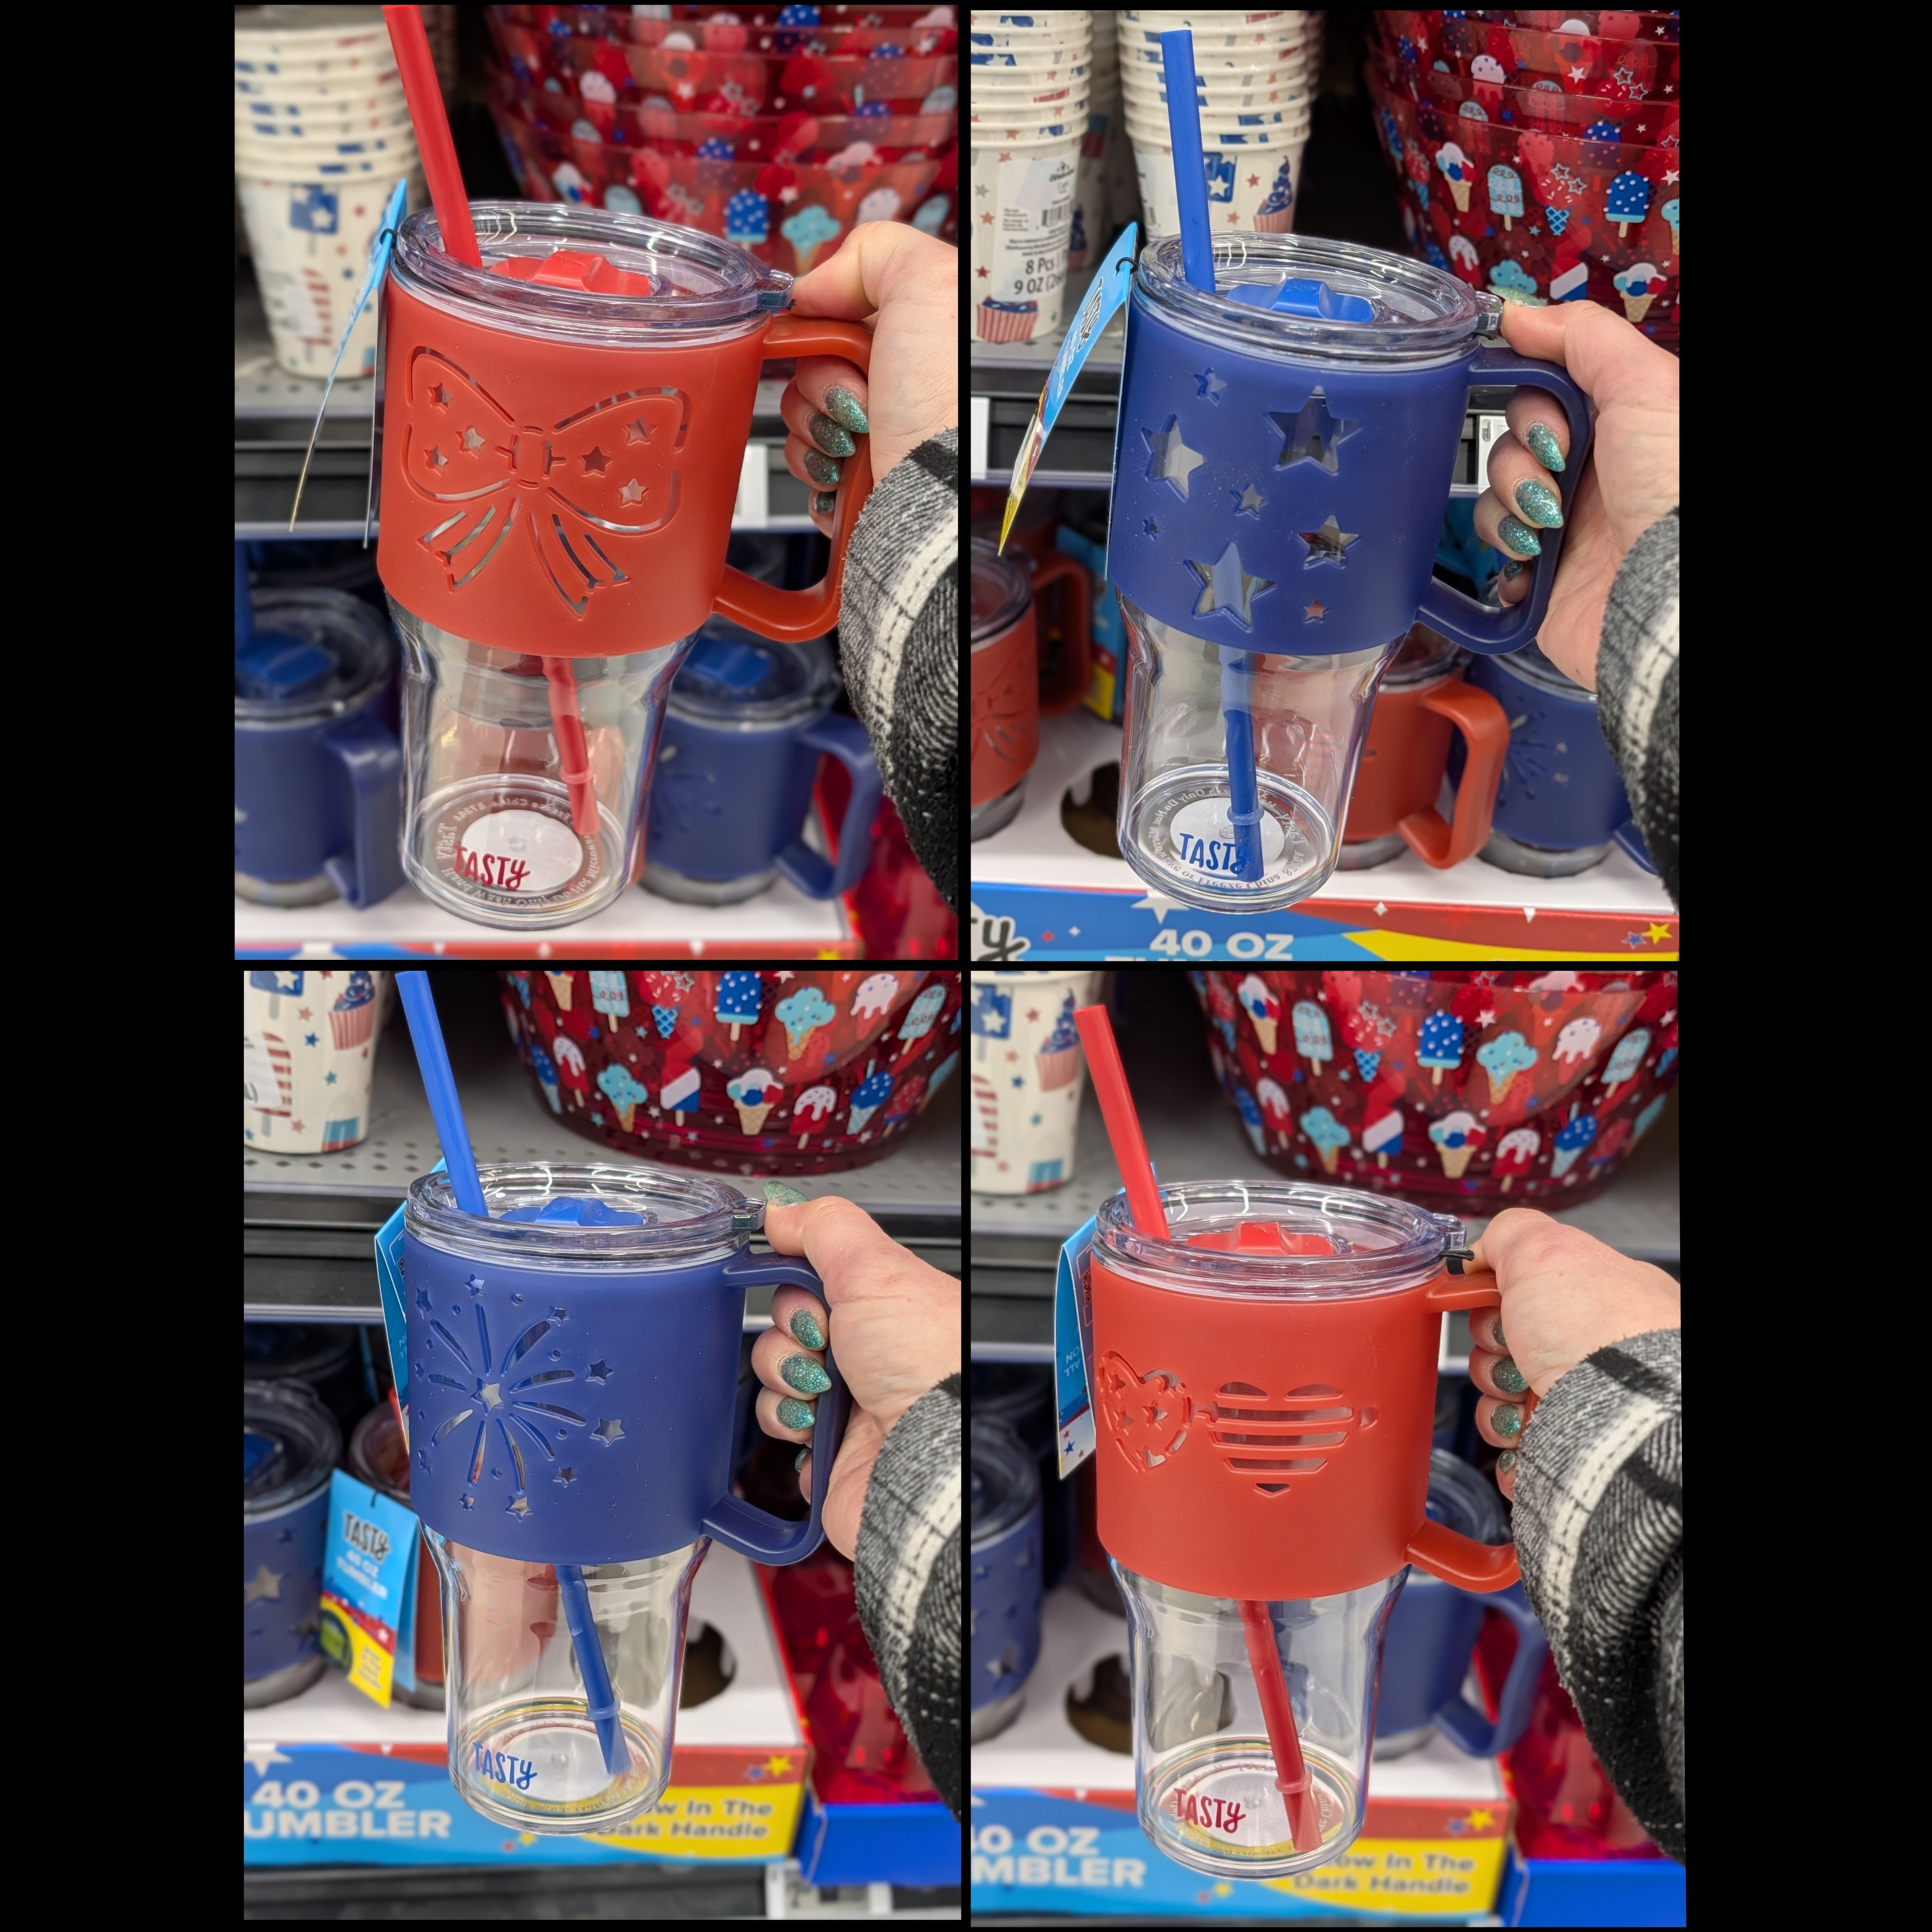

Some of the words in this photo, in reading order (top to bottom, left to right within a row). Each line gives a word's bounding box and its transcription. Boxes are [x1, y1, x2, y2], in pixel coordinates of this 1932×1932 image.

[1025, 259, 1034, 275] 8
[1014, 280, 1024, 295] 9
[453, 844, 531, 891] TASTY
[1149, 928, 1212, 957] 40
[1226, 931, 1294, 961] OZ
[344, 1511, 390, 1562] TASTY
[473, 1741, 538, 1790] TASTY
[251, 1780, 320, 1809] 40
[333, 1781, 406, 1809] OZ
[723, 1799, 774, 1817] The
[1174, 1787, 1248, 1834] TASTY
[598, 1821, 660, 1837] ark
[670, 1821, 769, 1838] Handle
[1026, 1825, 1101, 1857] OZ
